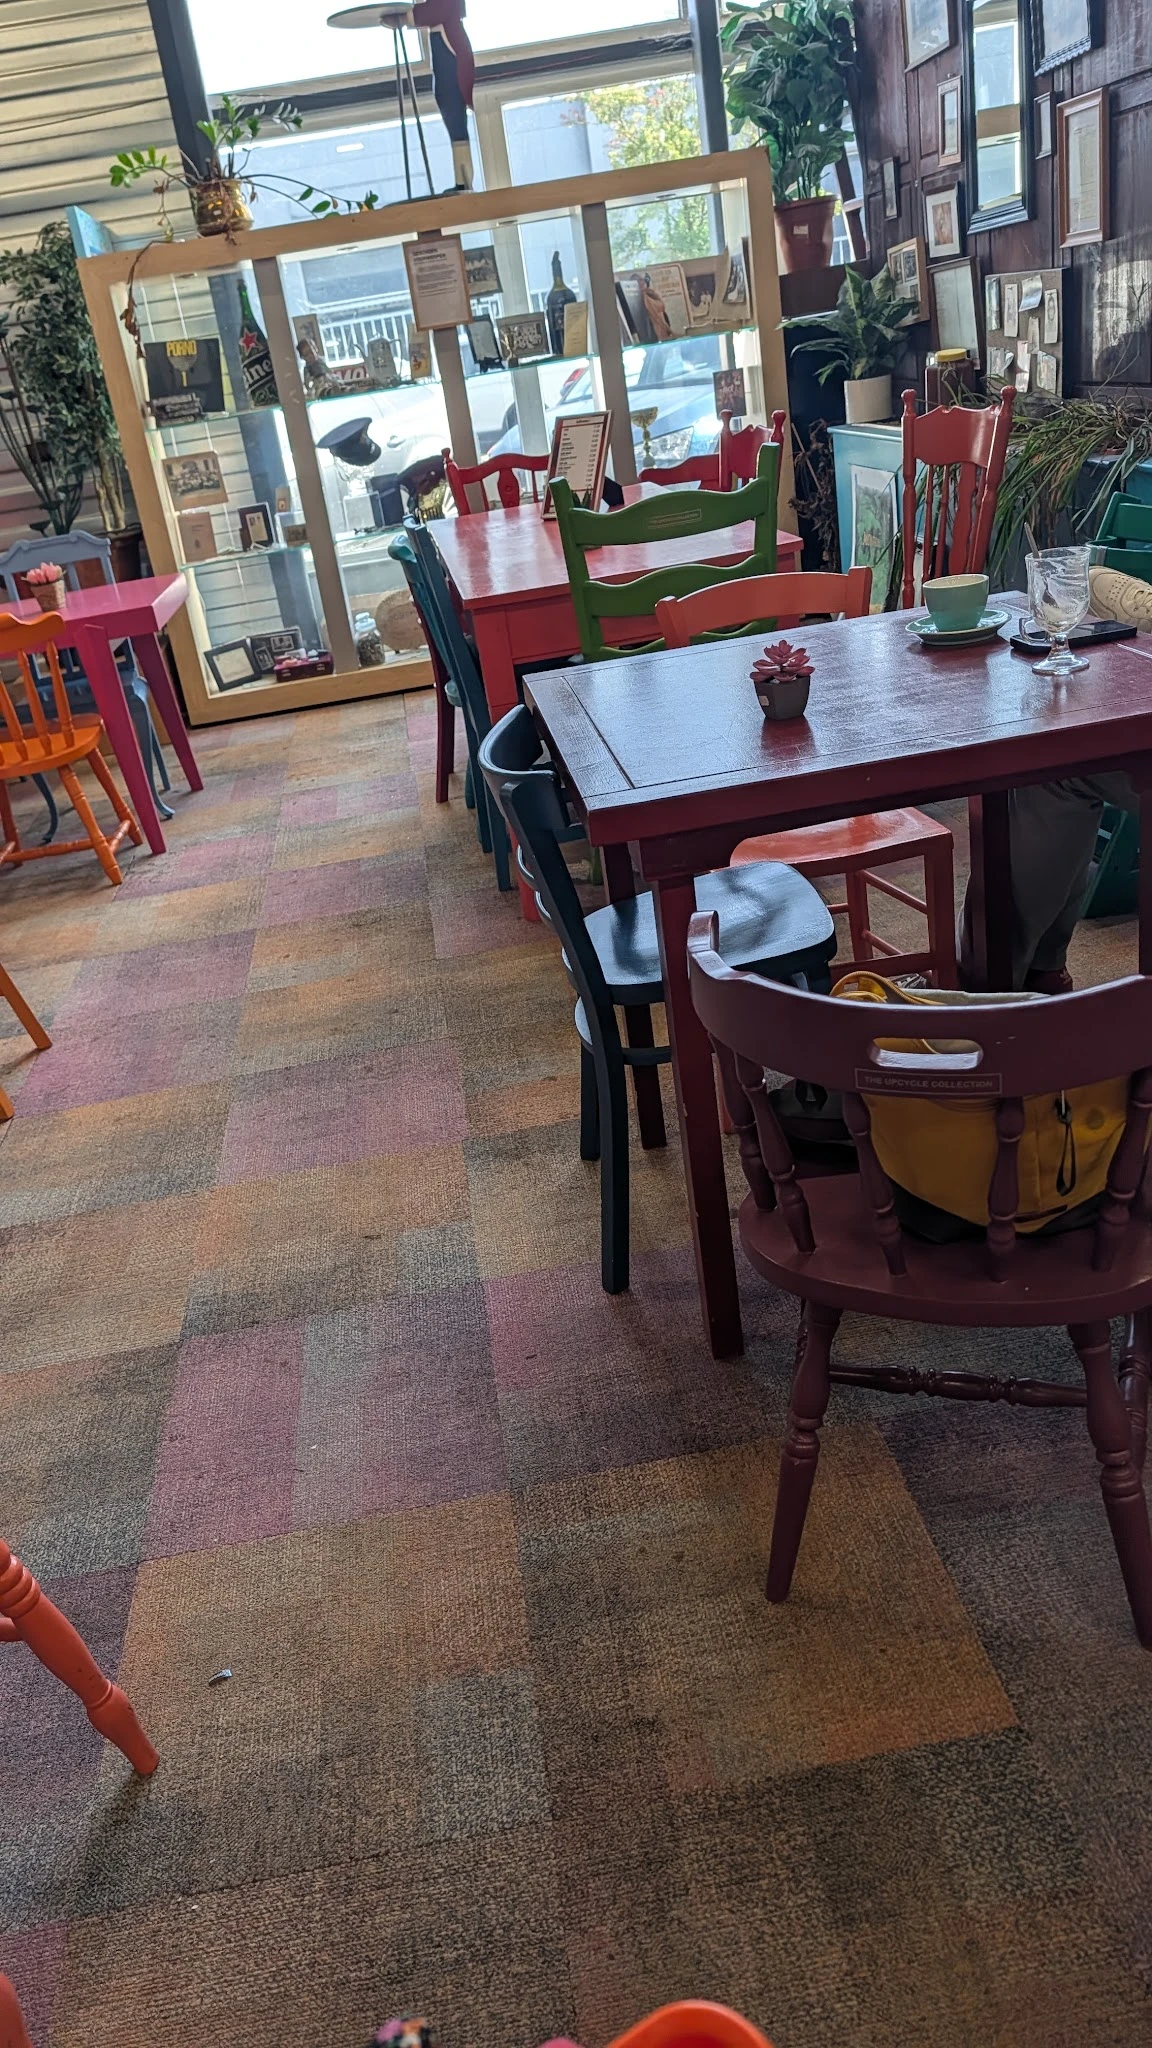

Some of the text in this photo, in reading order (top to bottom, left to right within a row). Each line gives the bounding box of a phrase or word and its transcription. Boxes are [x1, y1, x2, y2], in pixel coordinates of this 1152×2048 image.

[166, 340, 197, 357] PORNO
[864, 1076, 992, 1089] THE UPCYCLE COLLECTION
